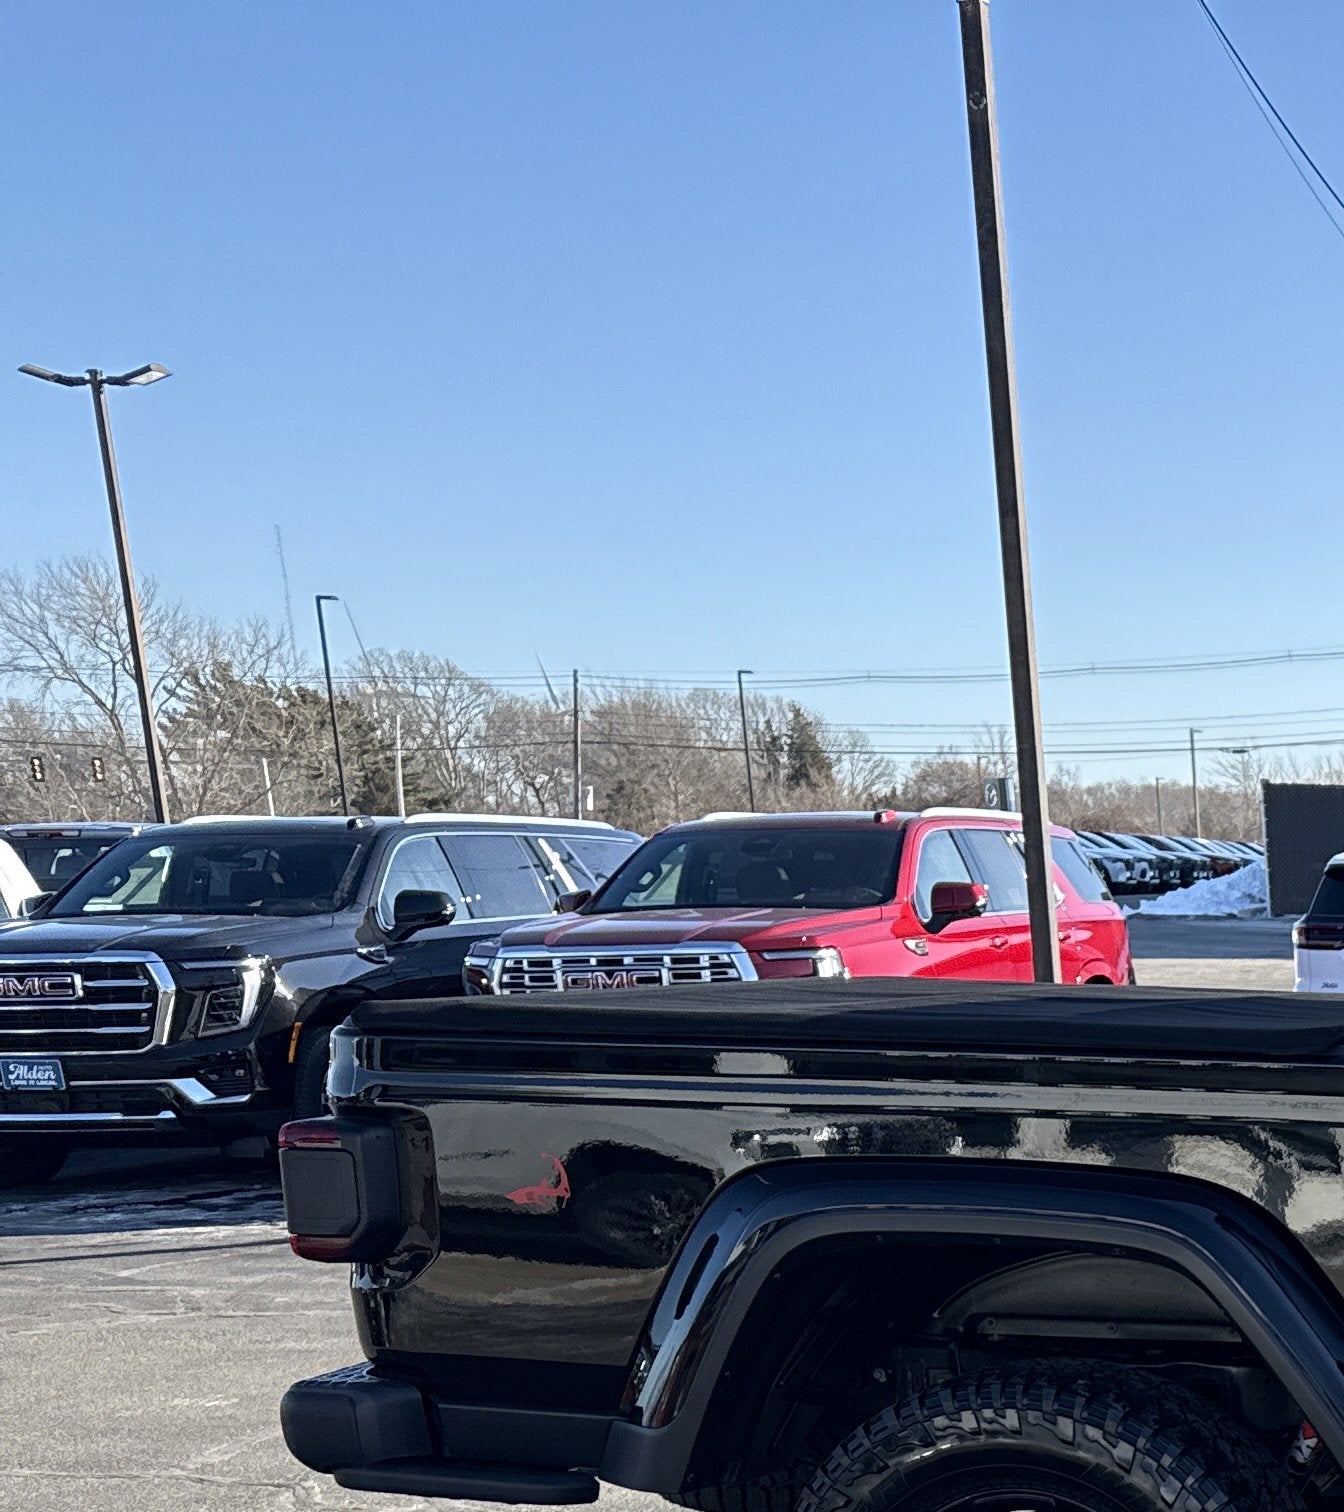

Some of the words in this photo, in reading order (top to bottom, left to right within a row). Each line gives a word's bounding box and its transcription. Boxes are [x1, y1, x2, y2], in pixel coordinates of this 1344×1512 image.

[0, 977, 73, 996] MC
[564, 971, 660, 991] GMC
[8, 1064, 56, 1079] Alden
